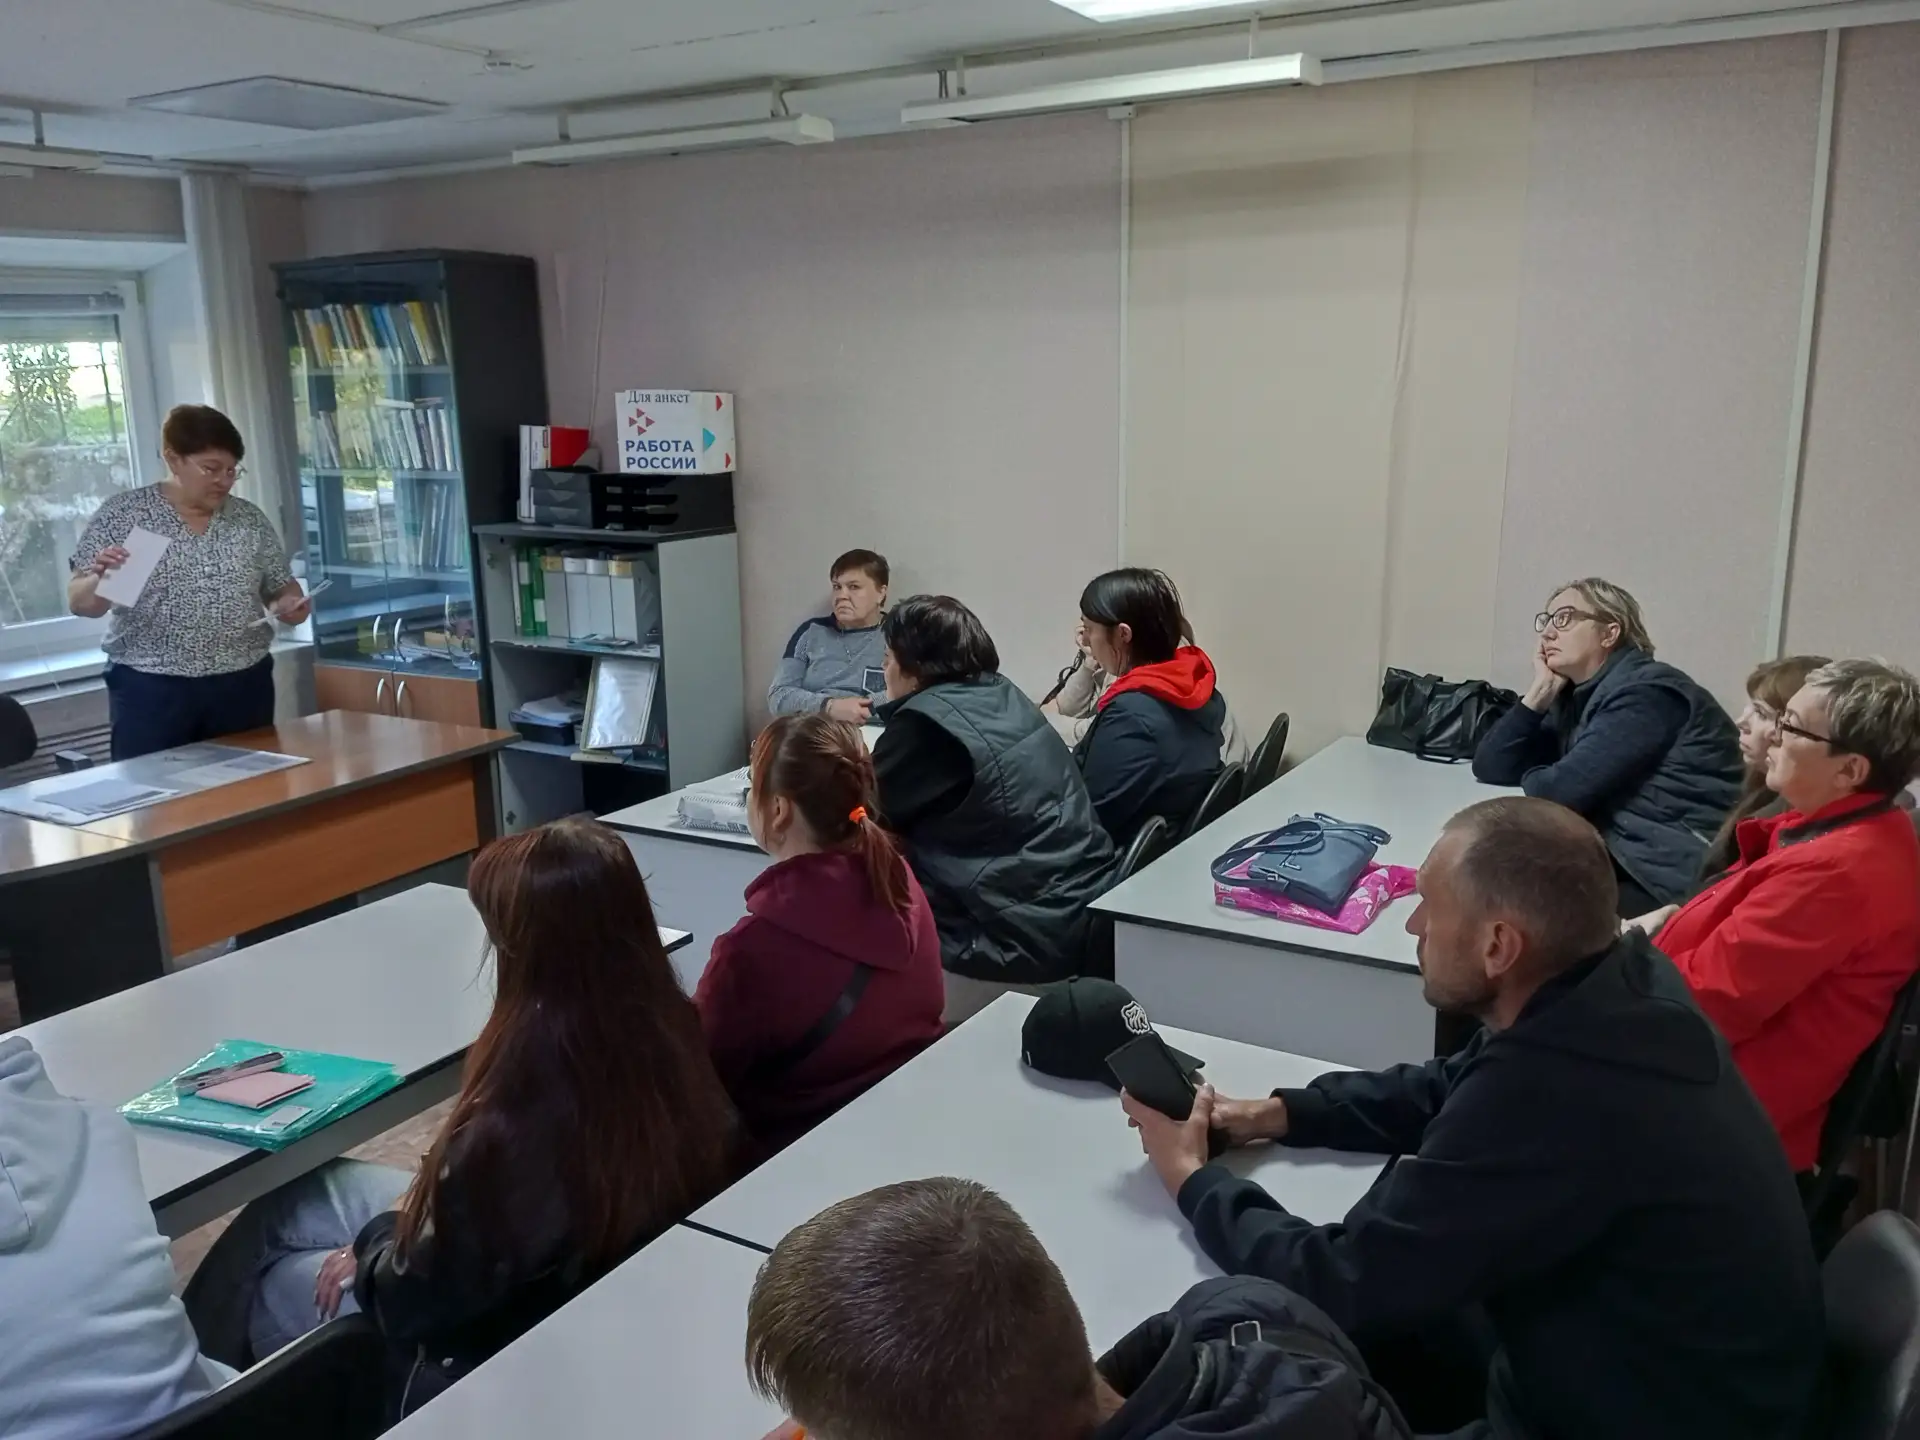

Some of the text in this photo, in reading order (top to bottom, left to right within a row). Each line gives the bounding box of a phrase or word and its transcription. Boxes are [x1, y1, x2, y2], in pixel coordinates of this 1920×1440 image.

[628, 391, 690, 404] Для анкет
[625, 440, 694, 453] РАБОТА
[626, 456, 697, 470] РОССИИ
